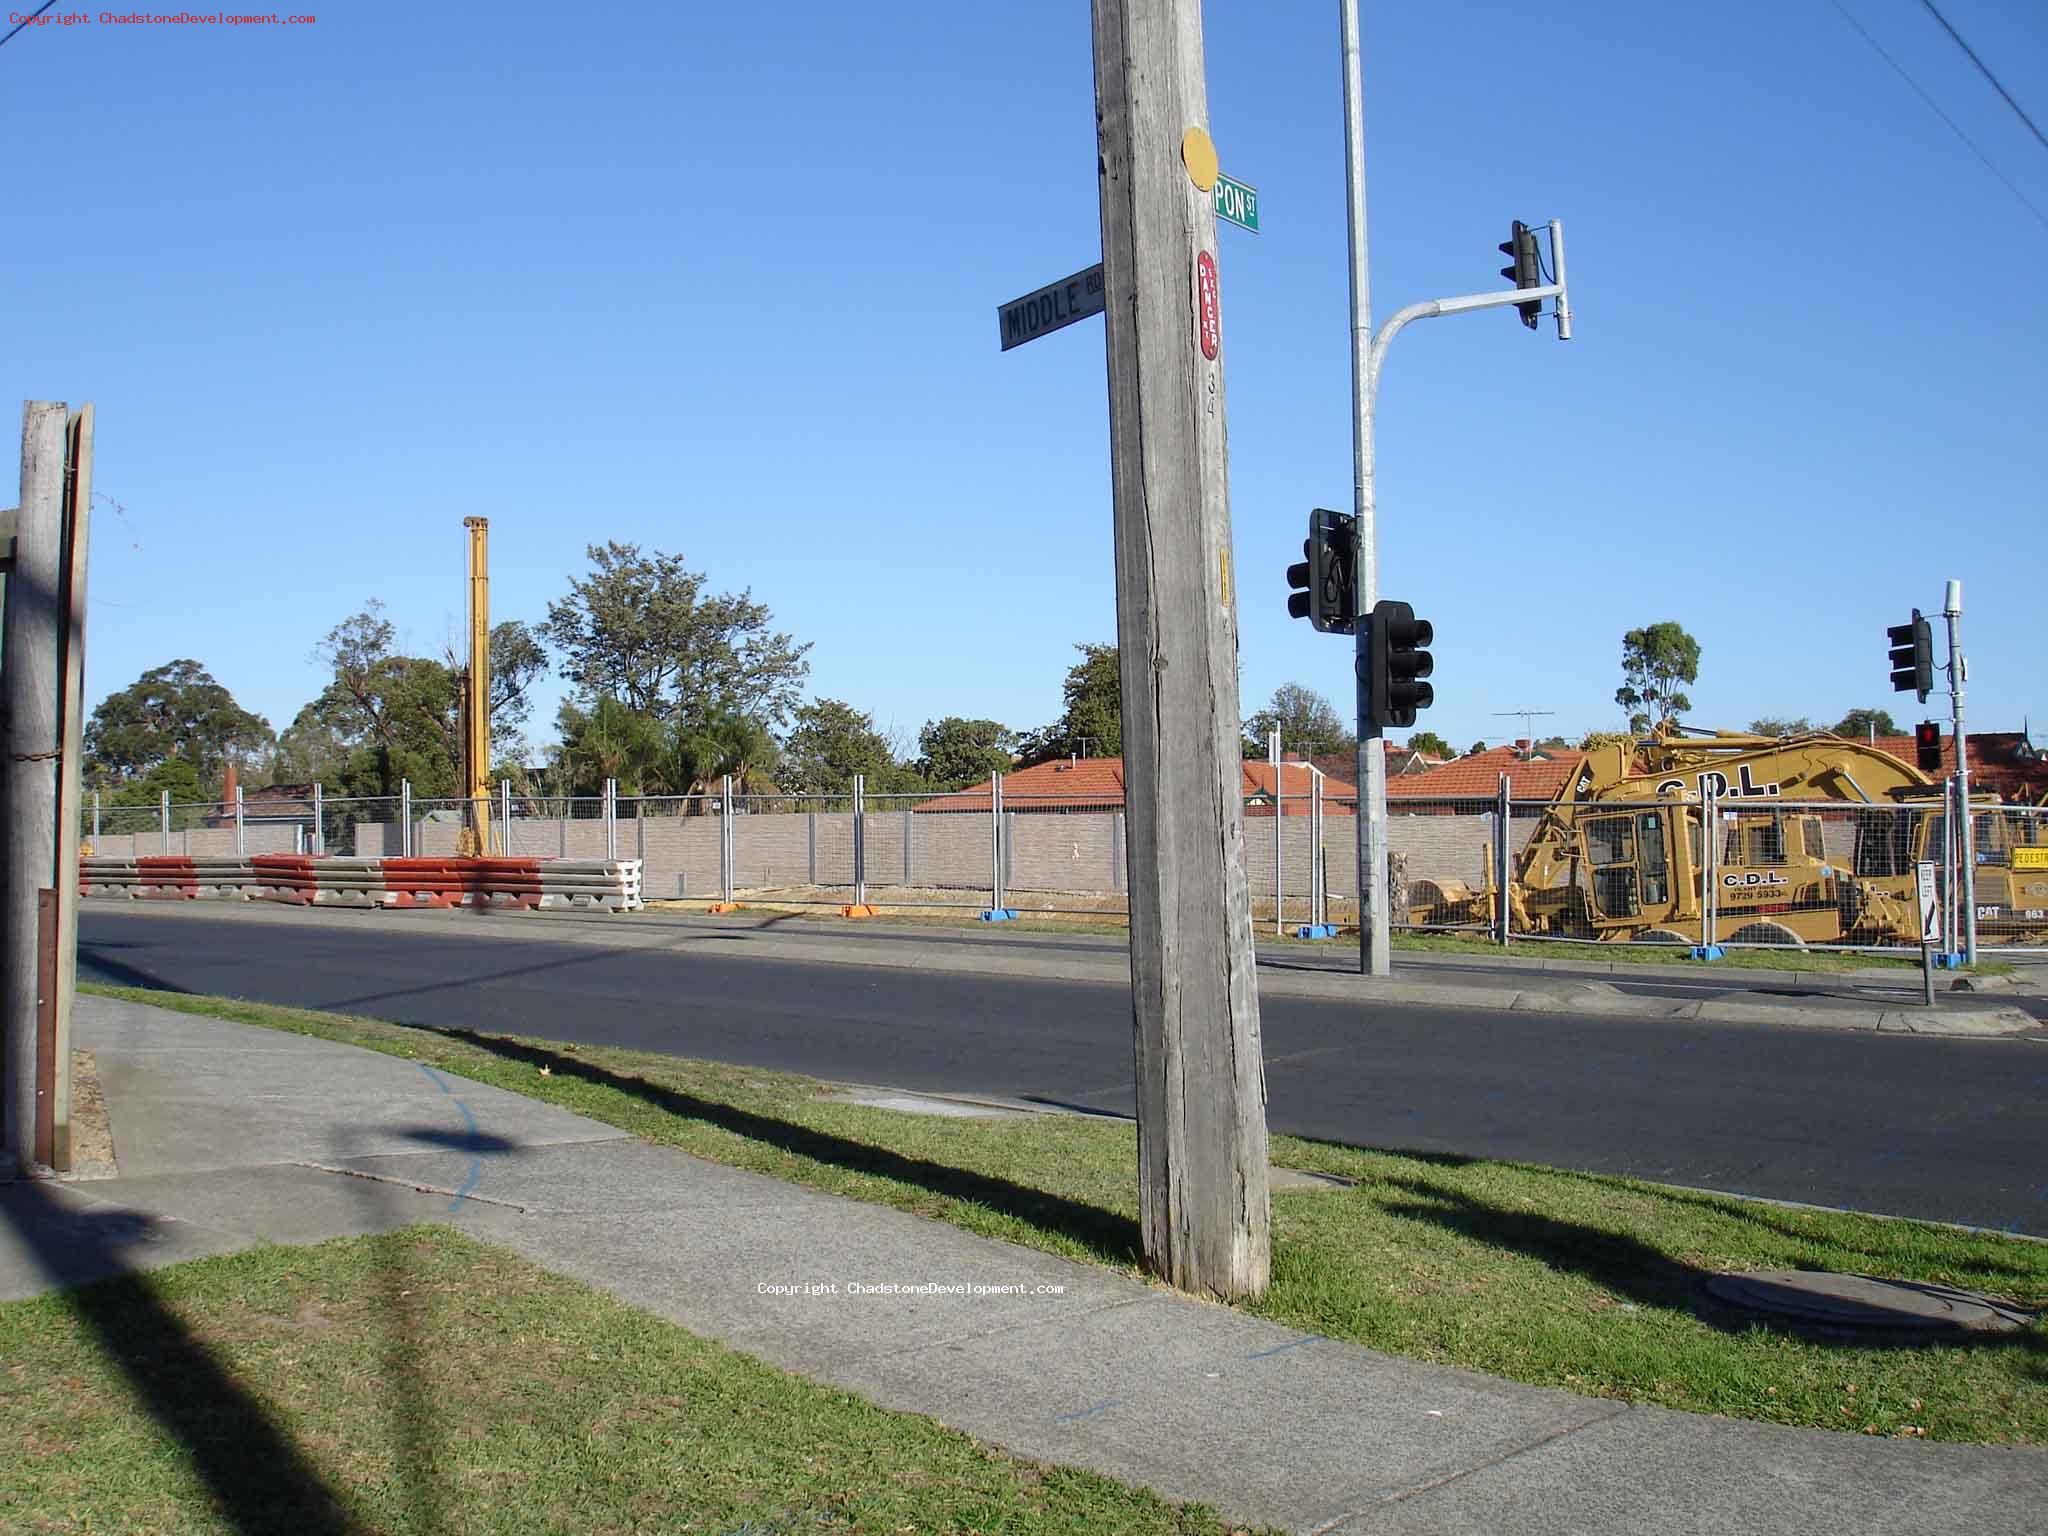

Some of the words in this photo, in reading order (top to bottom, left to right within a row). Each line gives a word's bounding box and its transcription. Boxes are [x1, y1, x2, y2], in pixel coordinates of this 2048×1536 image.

[1214, 180, 1245, 222] PON
[1246, 194, 1255, 216] ST
[1007, 281, 1081, 339] MIDDLE
[1576, 775, 1591, 793] CAT
[1722, 870, 1790, 889] C.D.L.
[1977, 906, 2000, 920] CAT
